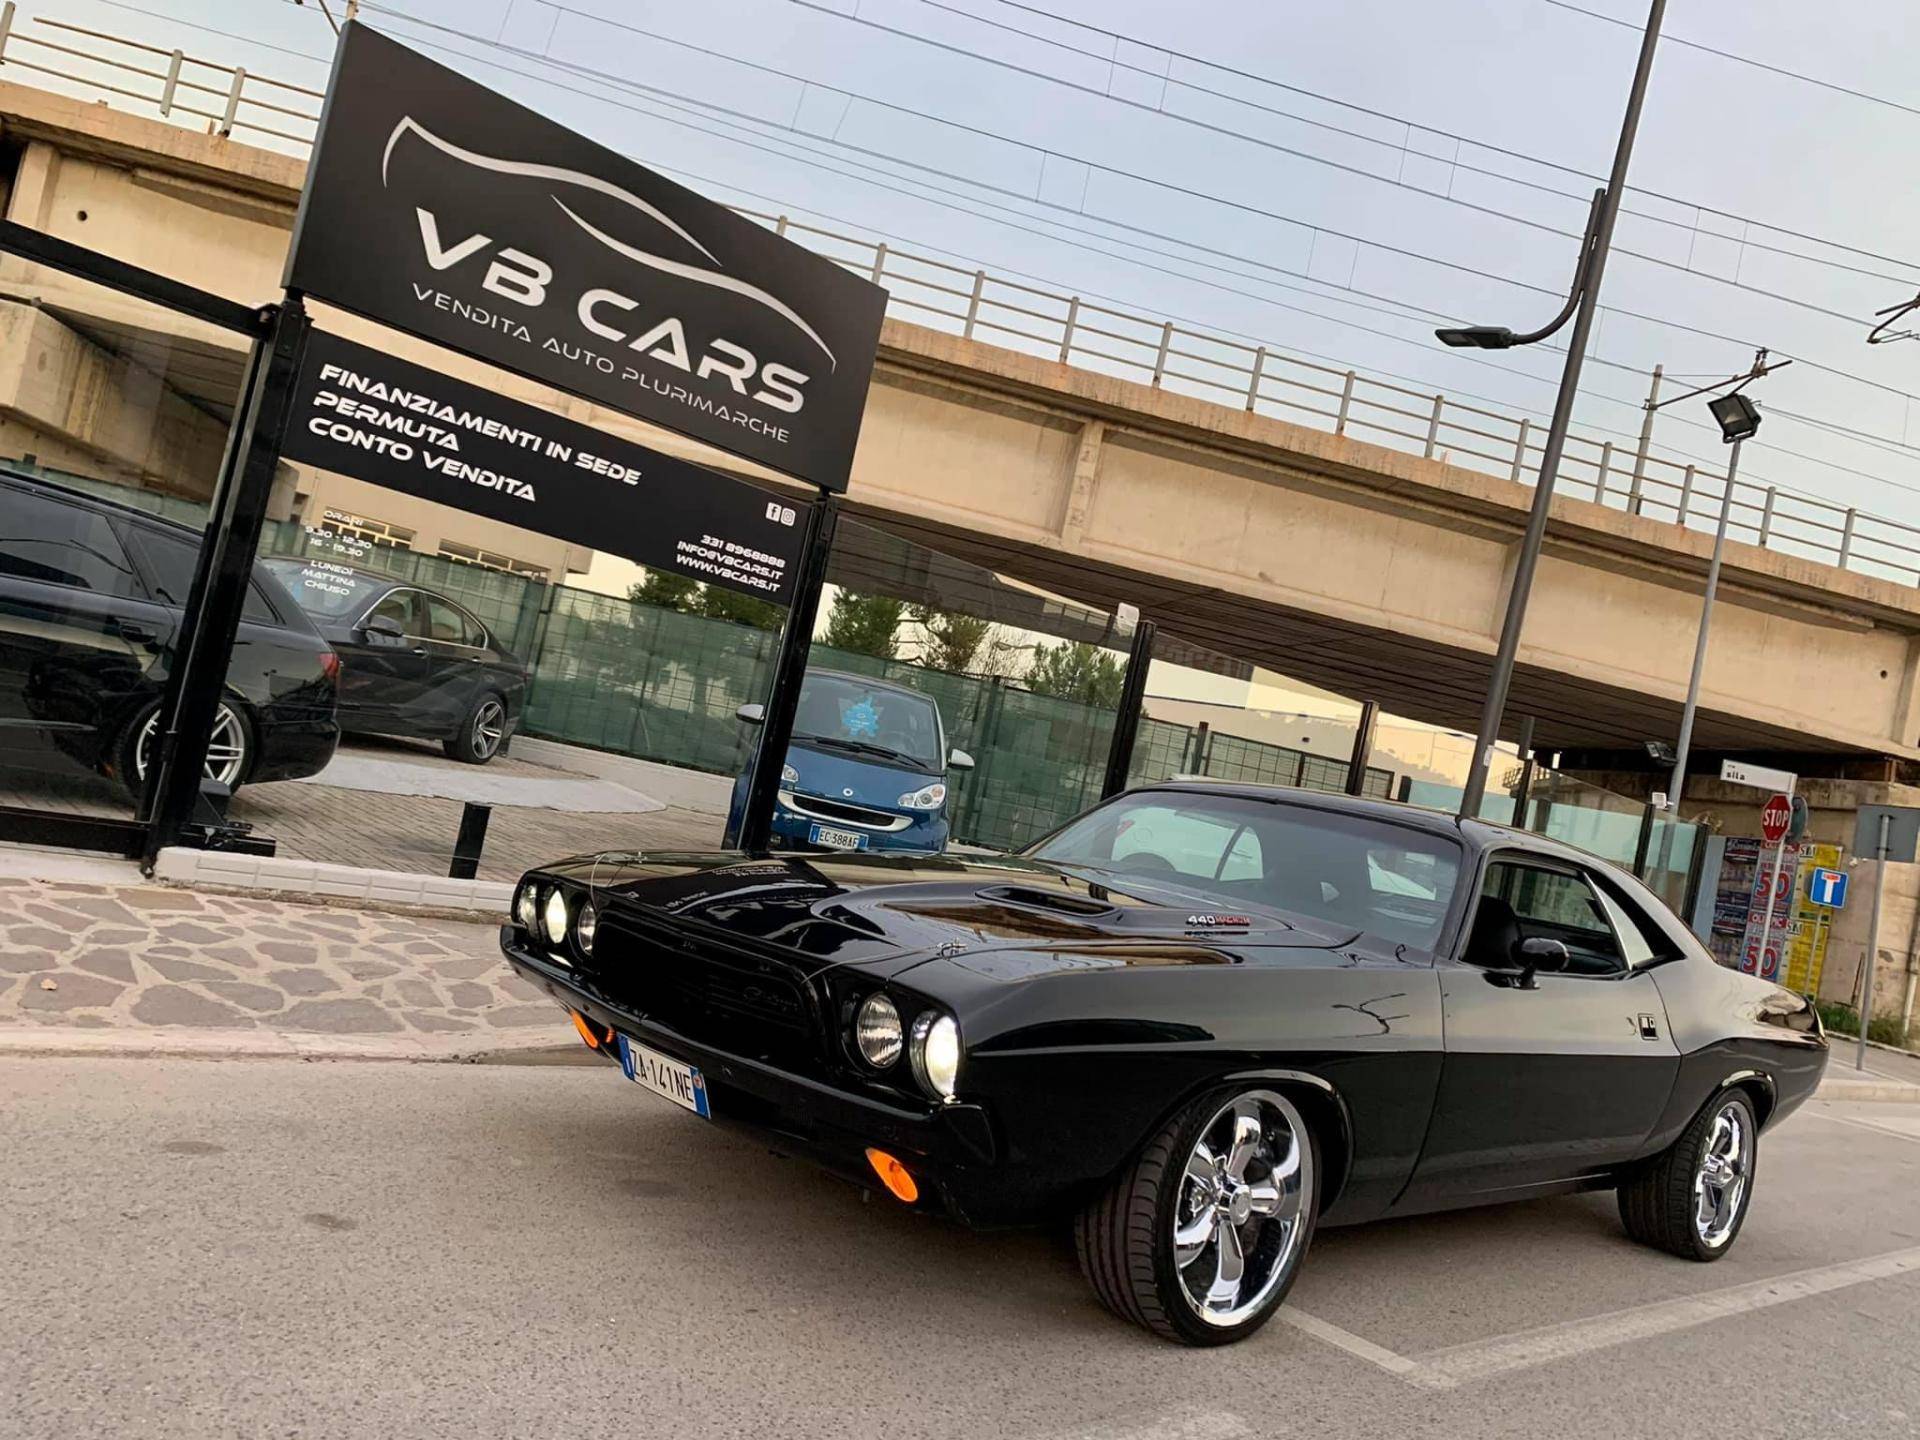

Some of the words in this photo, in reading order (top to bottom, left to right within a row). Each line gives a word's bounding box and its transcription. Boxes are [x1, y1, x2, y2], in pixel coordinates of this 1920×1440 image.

[416, 207, 553, 307] VB
[577, 289, 811, 414] CARS
[412, 282, 531, 343] VENDITA
[542, 337, 614, 373] AUTO
[622, 367, 790, 443] PLURIMARCHE
[313, 391, 460, 451] PERMUTA
[319, 364, 542, 452] FINANZIAMENTI
[545, 441, 572, 461] IN
[575, 452, 642, 486] SEDE
[309, 417, 413, 461] CONTO
[423, 451, 536, 502] VENDITA
[323, 511, 364, 526] ORARI
[700, 534, 724, 549] 331
[676, 554, 781, 592] WWW.VBCARS.IT
[677, 541, 784, 580] INFO@VBCARS.IT
[301, 569, 356, 587] MATTINA
[304, 580, 350, 596] CHIUSO
[1763, 809, 1789, 827] STOP
[1755, 871, 1791, 900] 50
[1188, 915, 1216, 925] 440
[1742, 946, 1777, 976] 50
